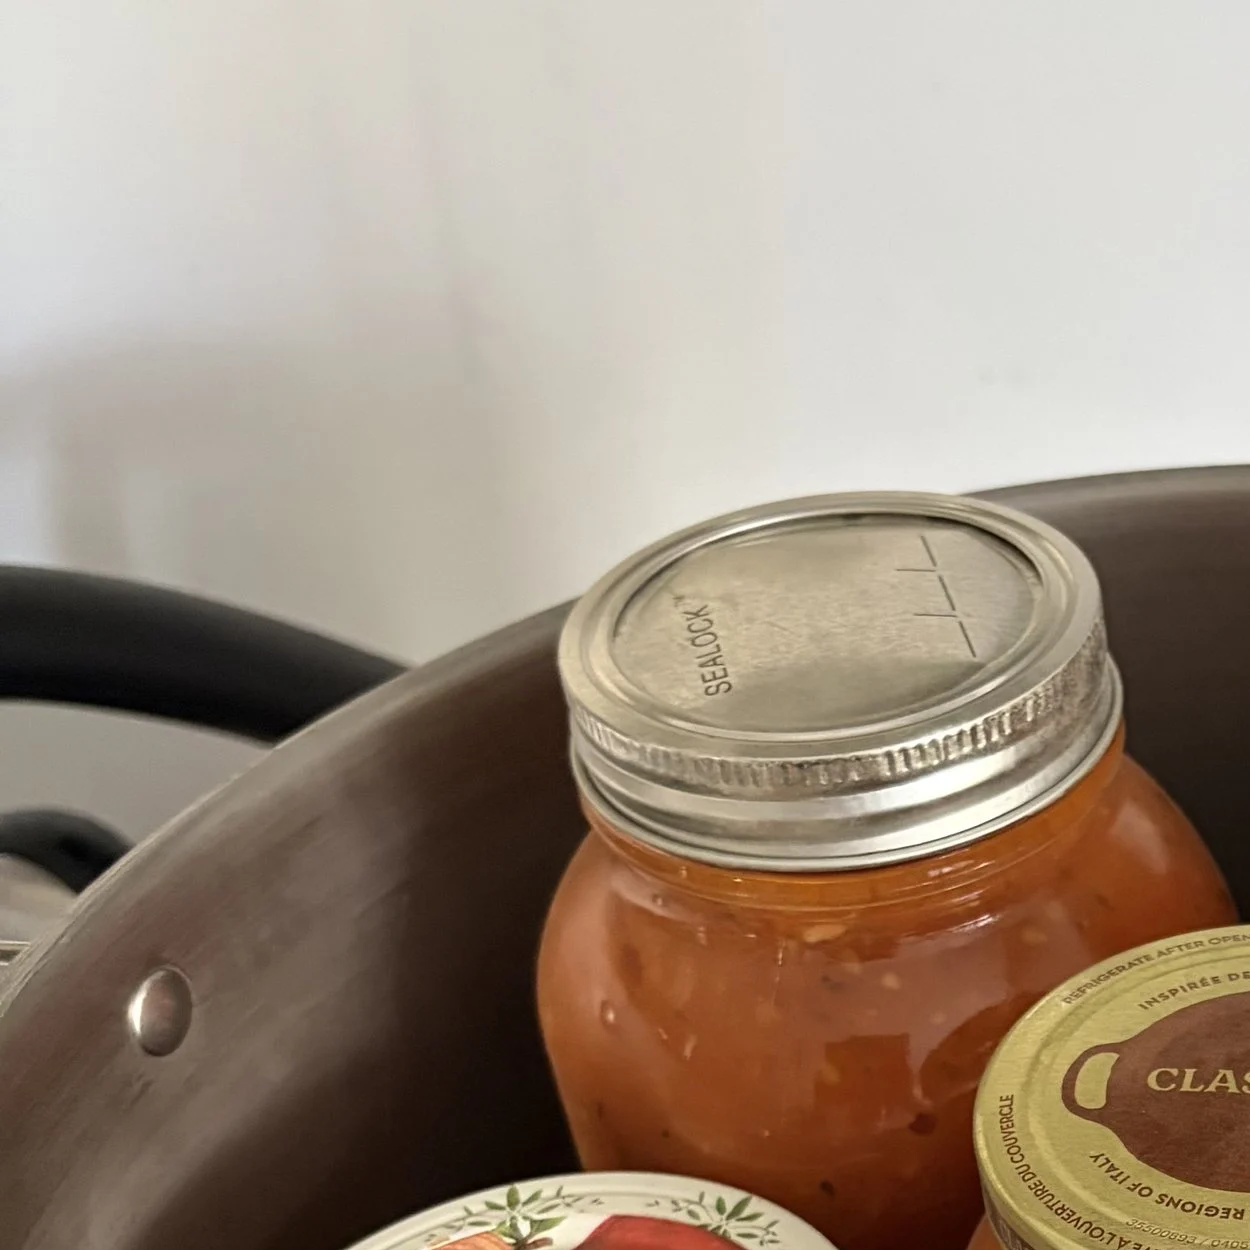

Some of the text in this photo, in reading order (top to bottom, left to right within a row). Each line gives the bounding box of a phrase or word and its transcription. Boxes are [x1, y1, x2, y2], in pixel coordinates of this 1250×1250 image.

[1063, 954, 1154, 1004] REFRIGERATE
[1155, 940, 1204, 959] AFTER
[1137, 972, 1222, 1011] INSPIRÉE
[999, 1094, 1025, 1164] COUVERCLE
[1015, 1164, 1037, 1183] DU
[1089, 1152, 1129, 1186] ITALY
[1126, 1182, 1153, 1199] OF
[1155, 1192, 1245, 1220] REGIONS
[1028, 1179, 1120, 1246] L'OUVERTURE
